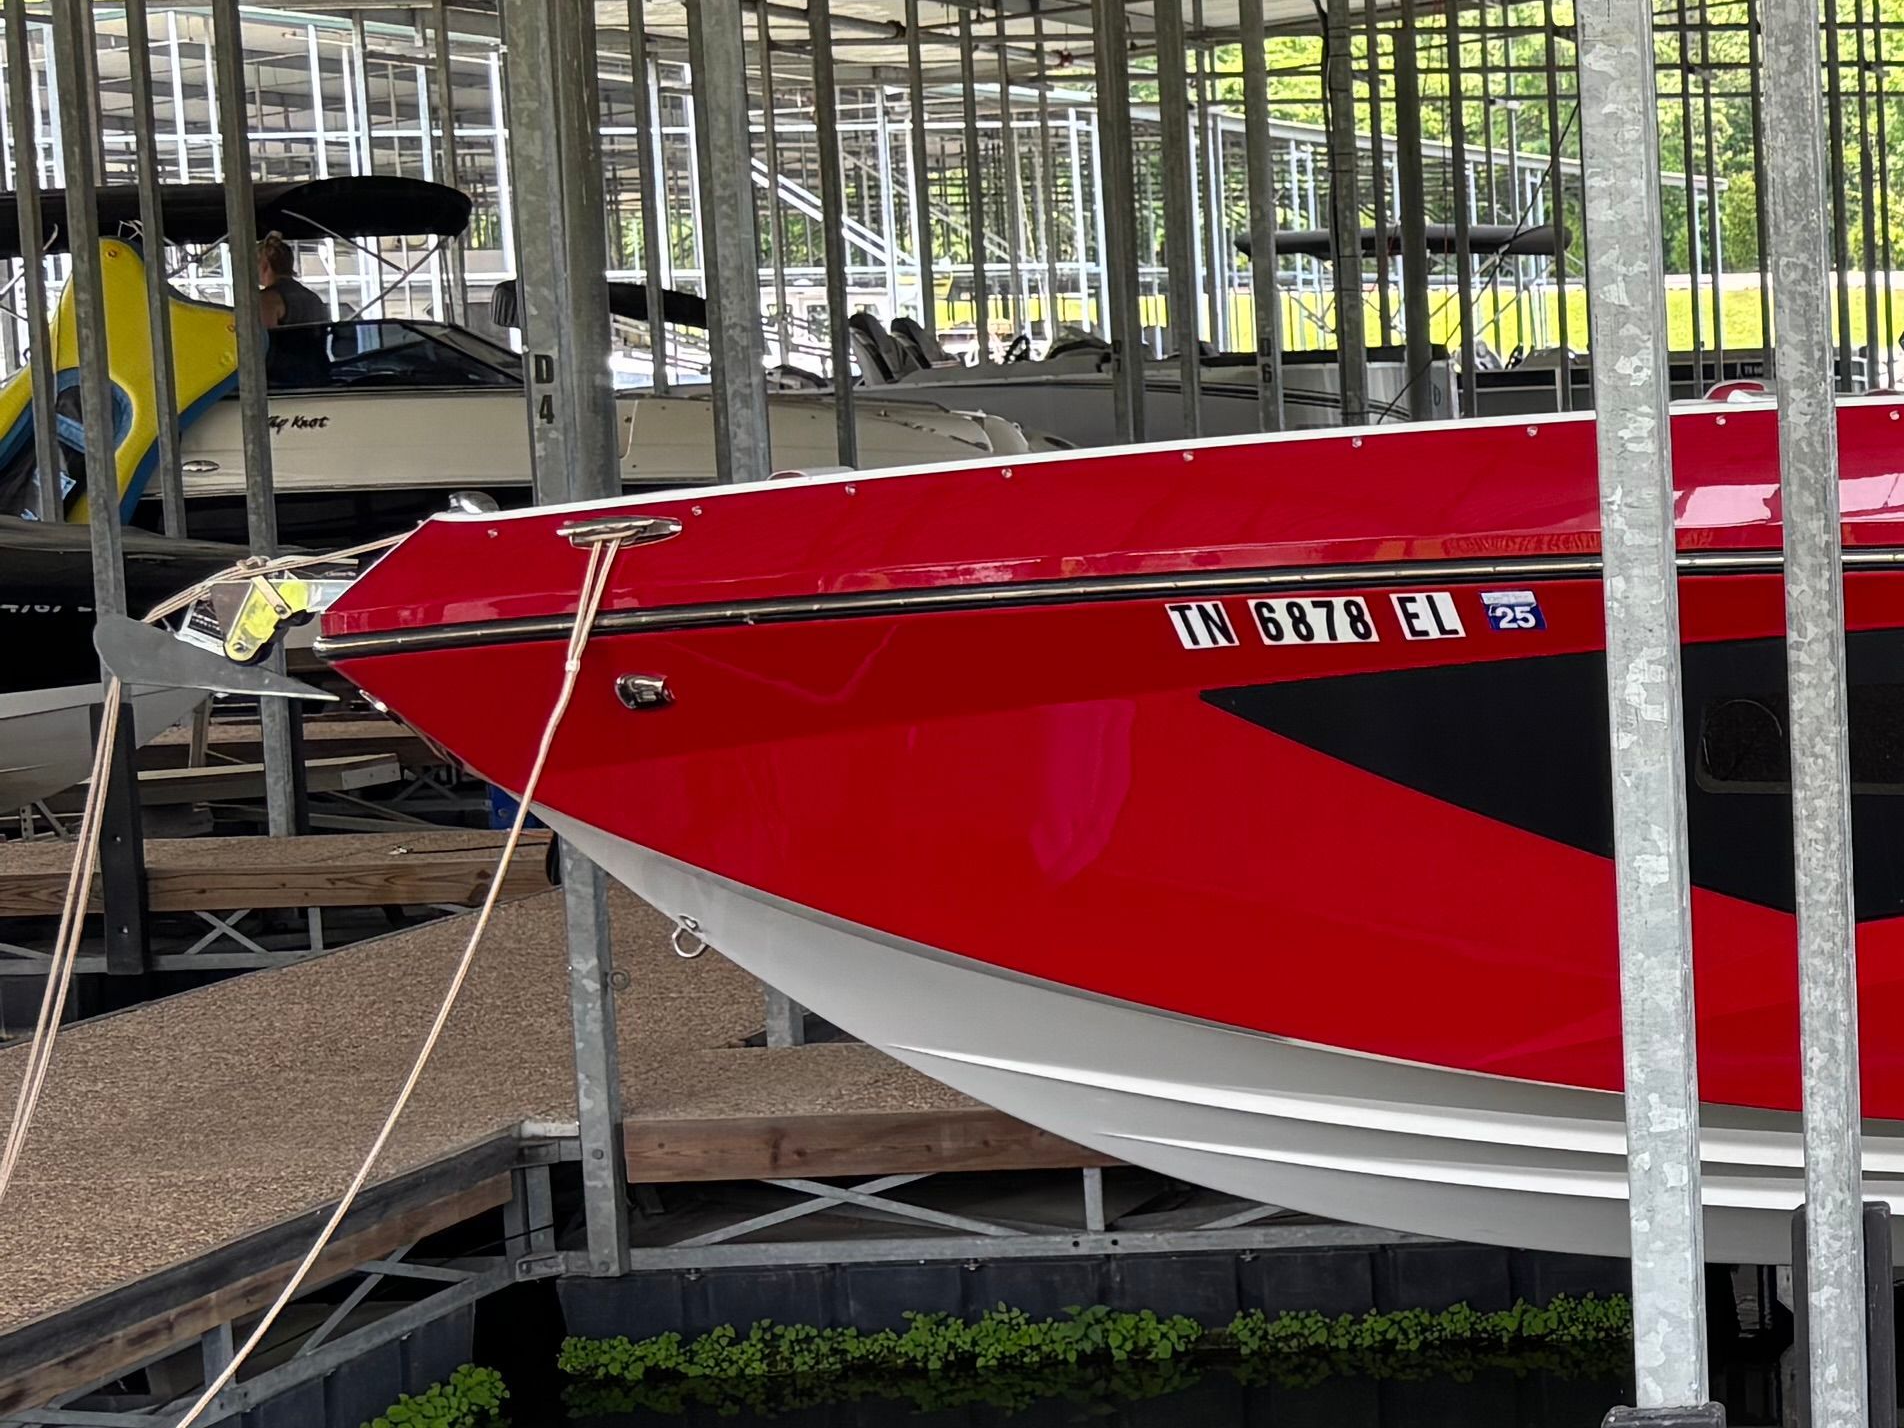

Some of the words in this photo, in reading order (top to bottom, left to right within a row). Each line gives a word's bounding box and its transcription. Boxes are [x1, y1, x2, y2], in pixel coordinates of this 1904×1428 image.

[534, 354, 554, 384] D
[1262, 363, 1272, 383] 6
[291, 415, 330, 429] Knot
[539, 394, 555, 424] 4
[1168, 603, 1236, 646] TN
[1254, 600, 1373, 642] 6878
[1396, 595, 1460, 638] EL
[1495, 606, 1536, 628] 25
